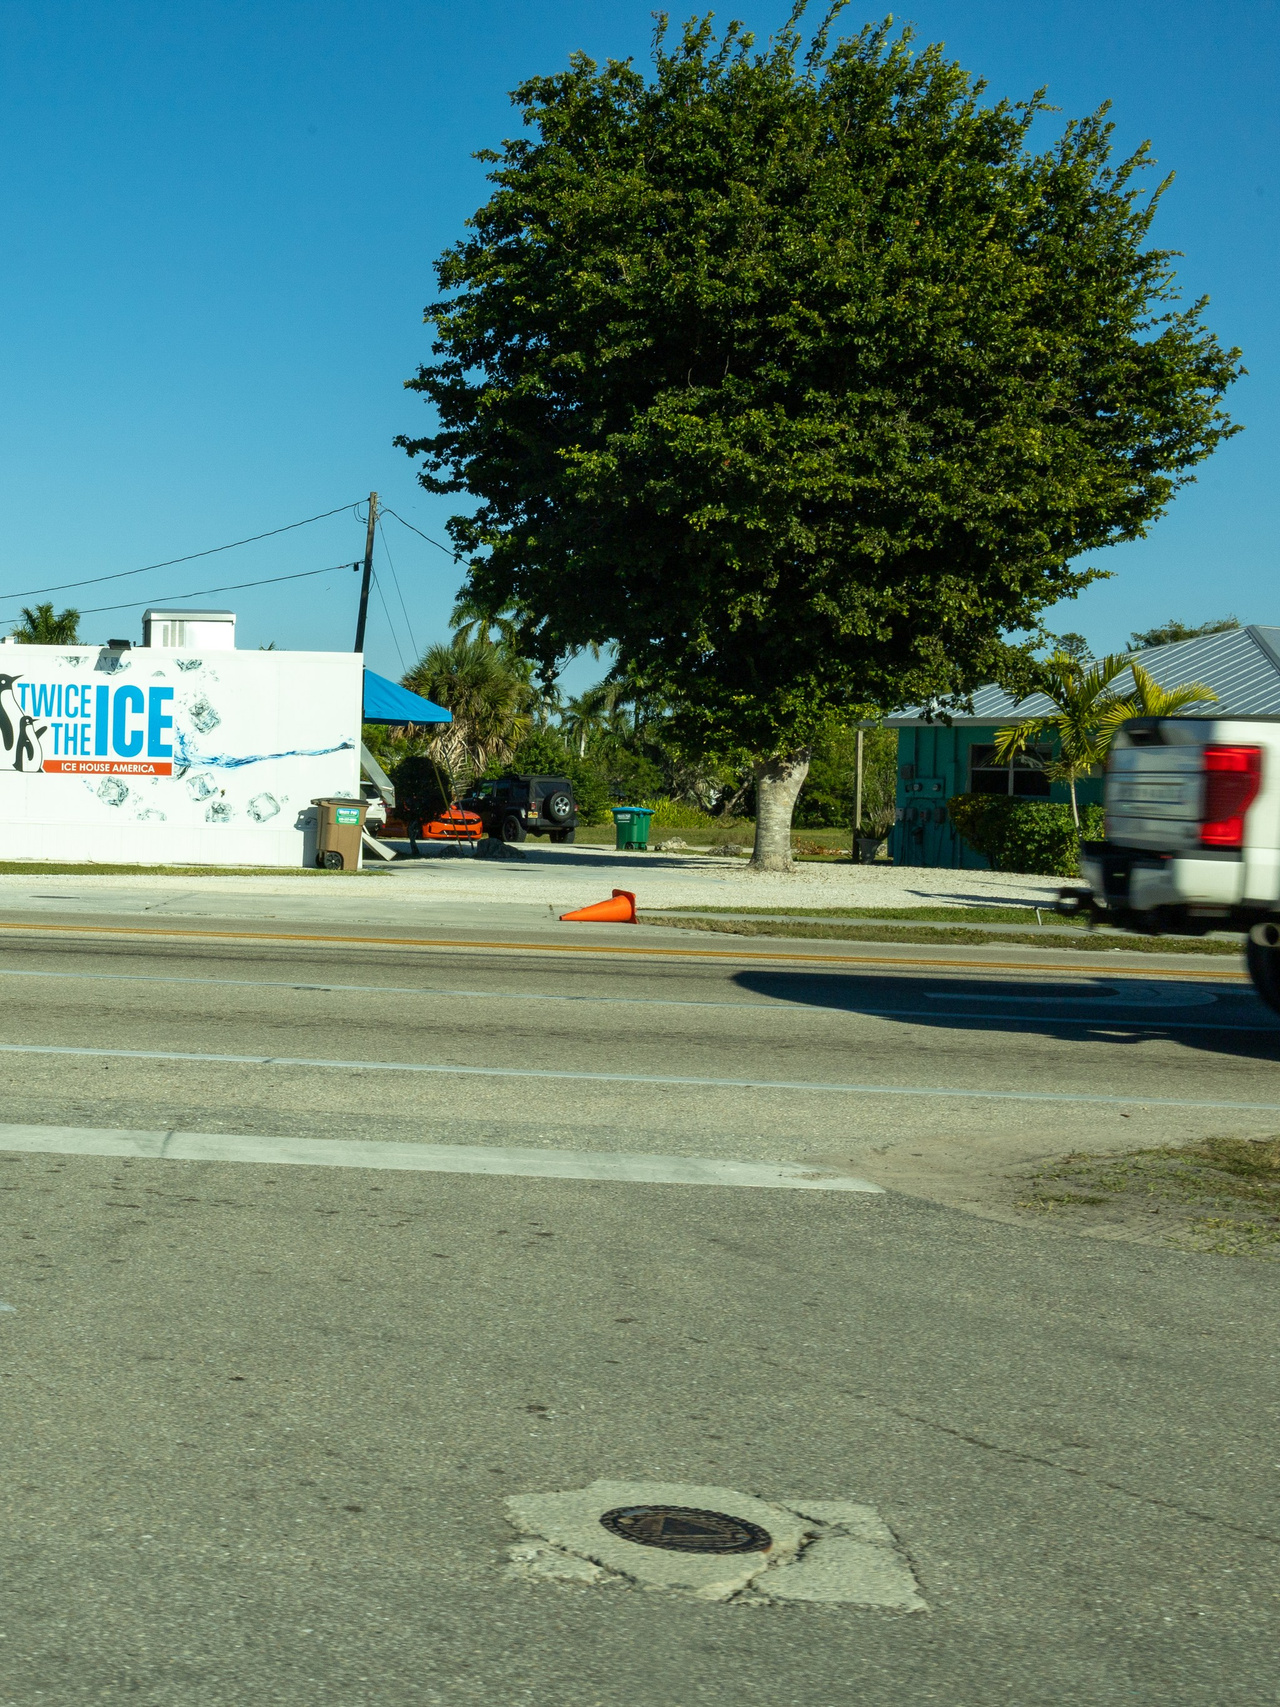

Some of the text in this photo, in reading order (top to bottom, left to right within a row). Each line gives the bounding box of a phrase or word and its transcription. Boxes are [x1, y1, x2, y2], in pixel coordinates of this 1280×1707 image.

[17, 683, 92, 718] TWICE
[95, 685, 174, 758] ICE
[51, 723, 91, 756] THE
[61, 762, 155, 773] ICE HOUSE AMERICA
